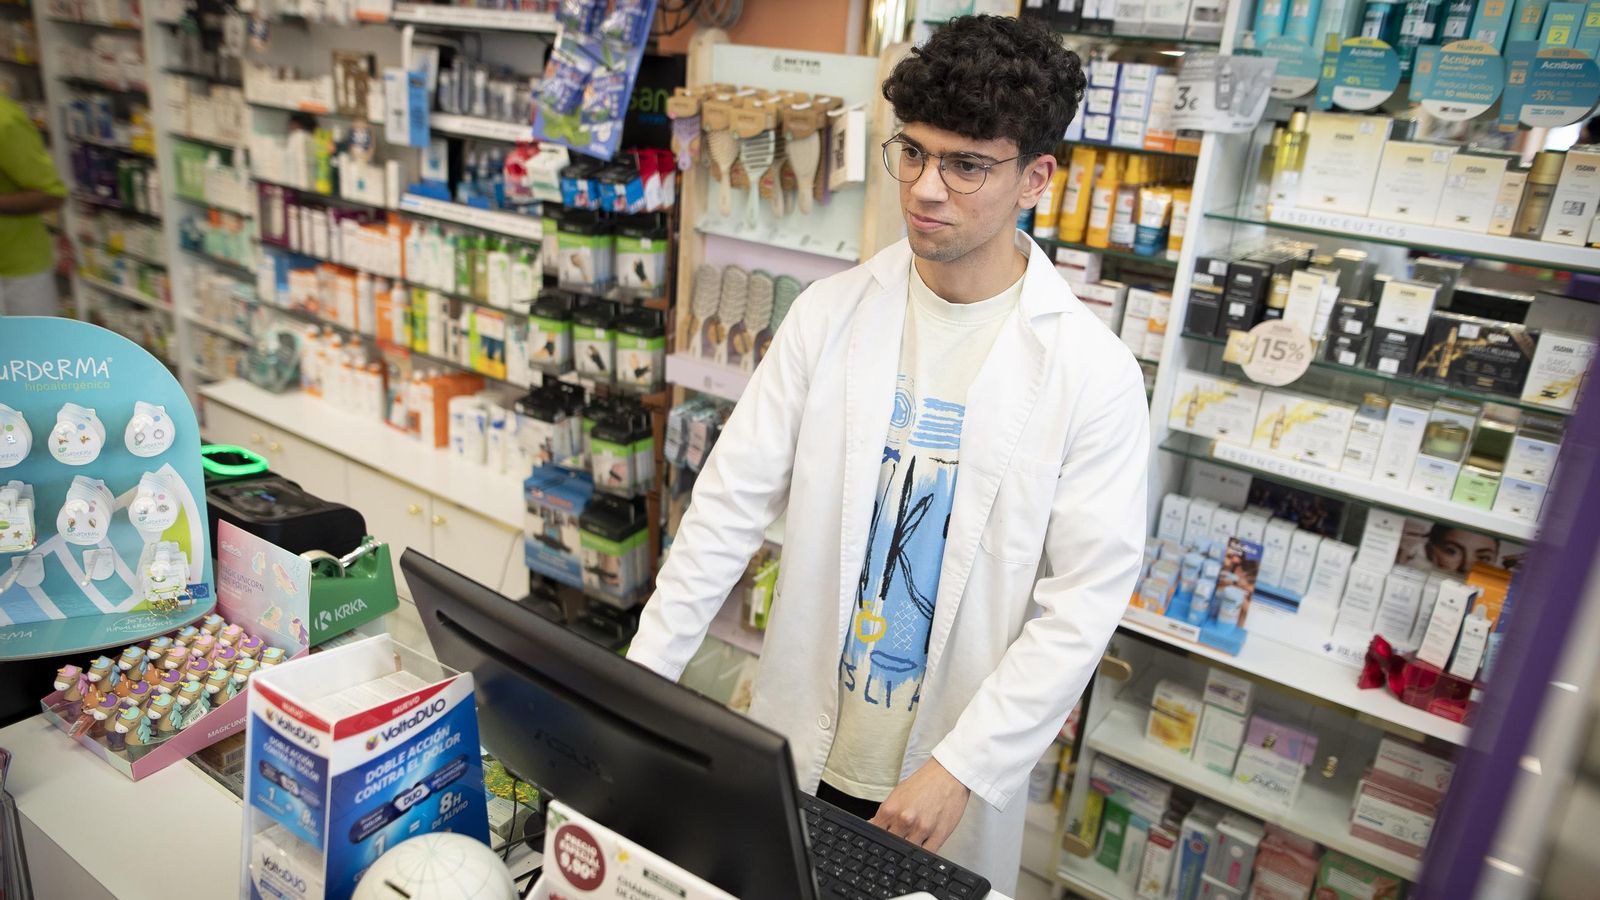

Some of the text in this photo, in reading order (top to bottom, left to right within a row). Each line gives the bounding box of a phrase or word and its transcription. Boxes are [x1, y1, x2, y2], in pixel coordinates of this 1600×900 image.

[1541, 60, 1585, 70] Acniben
[1260, 337, 1305, 361] 15%
[334, 598, 368, 622] KRKA
[391, 695, 421, 717] NUEVO
[381, 698, 446, 742] VoltaDUO
[365, 754, 406, 785] DOBLE
[406, 725, 450, 758] ACCIÓN
[354, 769, 405, 804] CONTRA
[404, 759, 421, 776] EL
[422, 732, 462, 761] DOLOR
[403, 788, 423, 806] DUO
[431, 800, 469, 830] DE ALIVIO
